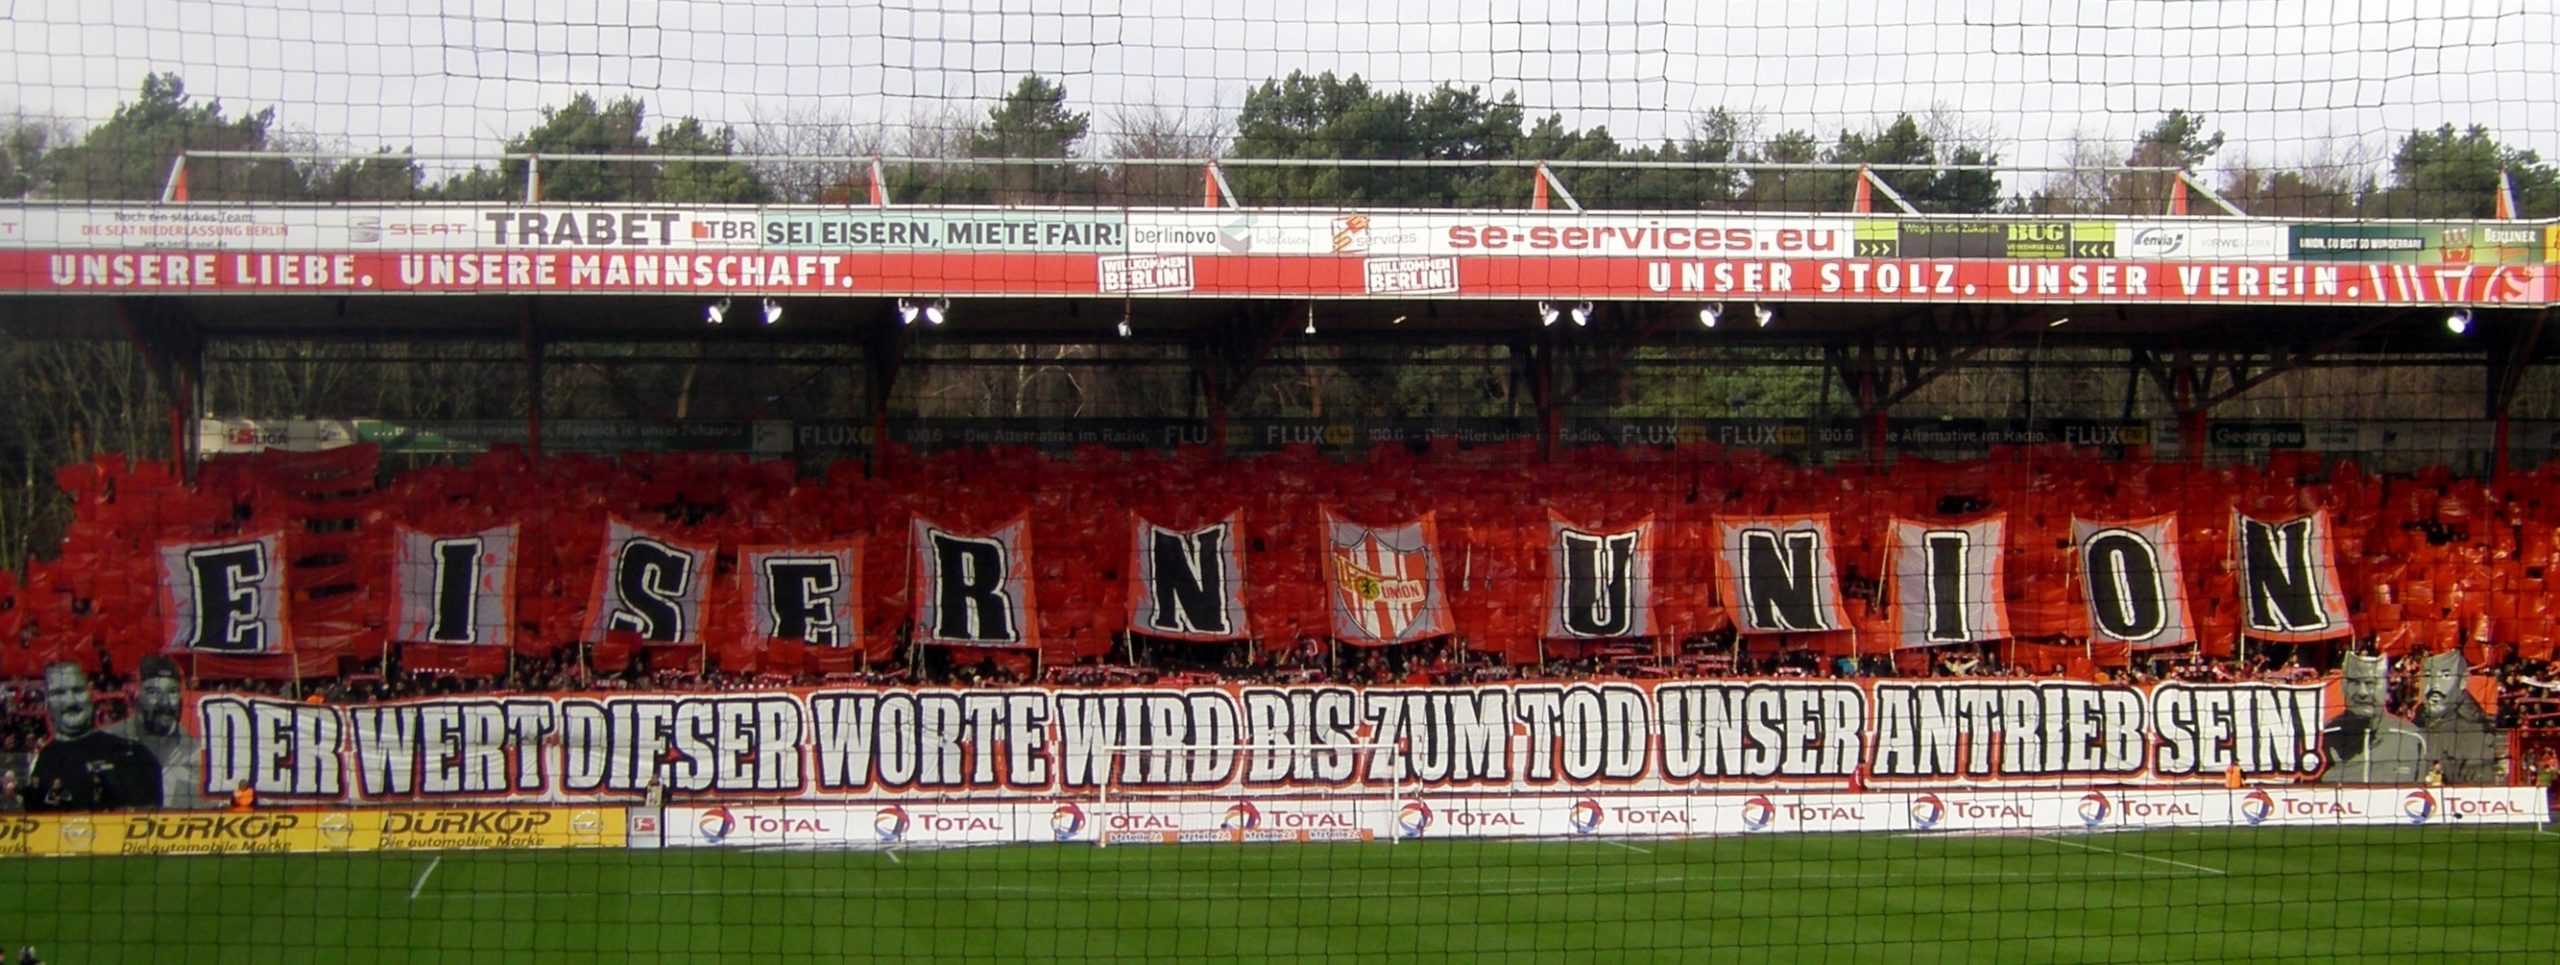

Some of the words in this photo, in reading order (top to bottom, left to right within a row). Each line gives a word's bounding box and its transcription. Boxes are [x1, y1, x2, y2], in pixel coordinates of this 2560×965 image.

[114, 212, 145, 223] Noch
[170, 212, 217, 223] starkes
[82, 225, 103, 237] DIE
[106, 225, 135, 237] SEAT
[139, 225, 242, 237] NIEDERLASSUNG
[246, 225, 289, 237] BERLIN
[390, 224, 468, 235] SEAT
[486, 213, 680, 246] TRABET
[706, 221, 756, 239] TBR
[767, 222, 813, 244] SEI
[822, 222, 939, 247] EISERN,
[947, 223, 1038, 245] MIETE
[1046, 223, 1122, 245] FAIR!
[1135, 227, 1216, 244] berlinovo
[1448, 221, 1835, 251] se-services.eu
[1945, 223, 1958, 234] die
[2007, 223, 2065, 241] BUG
[1356, 231, 1417, 247] services
[51, 254, 216, 286] UNSERE
[236, 254, 374, 287] LIEBE.
[401, 255, 556, 286] UNSERE
[571, 255, 854, 288] MANNSCHAFT.
[1103, 256, 1187, 273] WILLKOMMEN
[1369, 257, 1451, 274] WILLKOMMEN
[1105, 266, 1188, 291] BERLIN!
[1370, 269, 1452, 292] BERLIN!
[1648, 261, 1793, 292] UNSER
[1821, 262, 1976, 296] STOLZ.
[2007, 264, 2148, 295] UNSER
[2178, 265, 2360, 298] VEREIN.
[255, 432, 288, 444] LIGA
[1381, 584, 1421, 600] UNION
[202, 698, 344, 796] DER
[351, 700, 554, 796] WERT
[562, 697, 803, 793] DIESER
[812, 692, 1049, 790] WORTE
[1056, 691, 1239, 786] WIRD
[1244, 689, 1355, 784] BIS
[1364, 688, 1510, 782] ZUM
[1515, 686, 1650, 780] TOD
[1658, 685, 1864, 779] UNSER
[1871, 684, 2145, 778] ANTRIEB
[2153, 685, 2322, 776] SEIN!
[1784, 804, 1865, 821] TOTAL
[1953, 802, 2033, 819] TOTAL
[2118, 800, 2199, 816] TOTAL
[2282, 799, 2362, 815] TOTAL
[2445, 797, 2524, 813] TOTAL
[382, 811, 552, 835] DÜRKOP
[744, 815, 831, 833] TOTAL
[918, 814, 1004, 831] TOTAL
[1269, 810, 1353, 828] TOTAL
[1441, 808, 1525, 826] TOTAL
[1612, 807, 1697, 824] TOTAL
[126, 814, 299, 840] DÜRKOP
[121, 841, 146, 854] Die
[151, 840, 238, 855] automobile
[241, 840, 292, 852] Marke
[378, 836, 405, 848] Die
[408, 836, 492, 848] automobile
[496, 835, 545, 847] Marke
